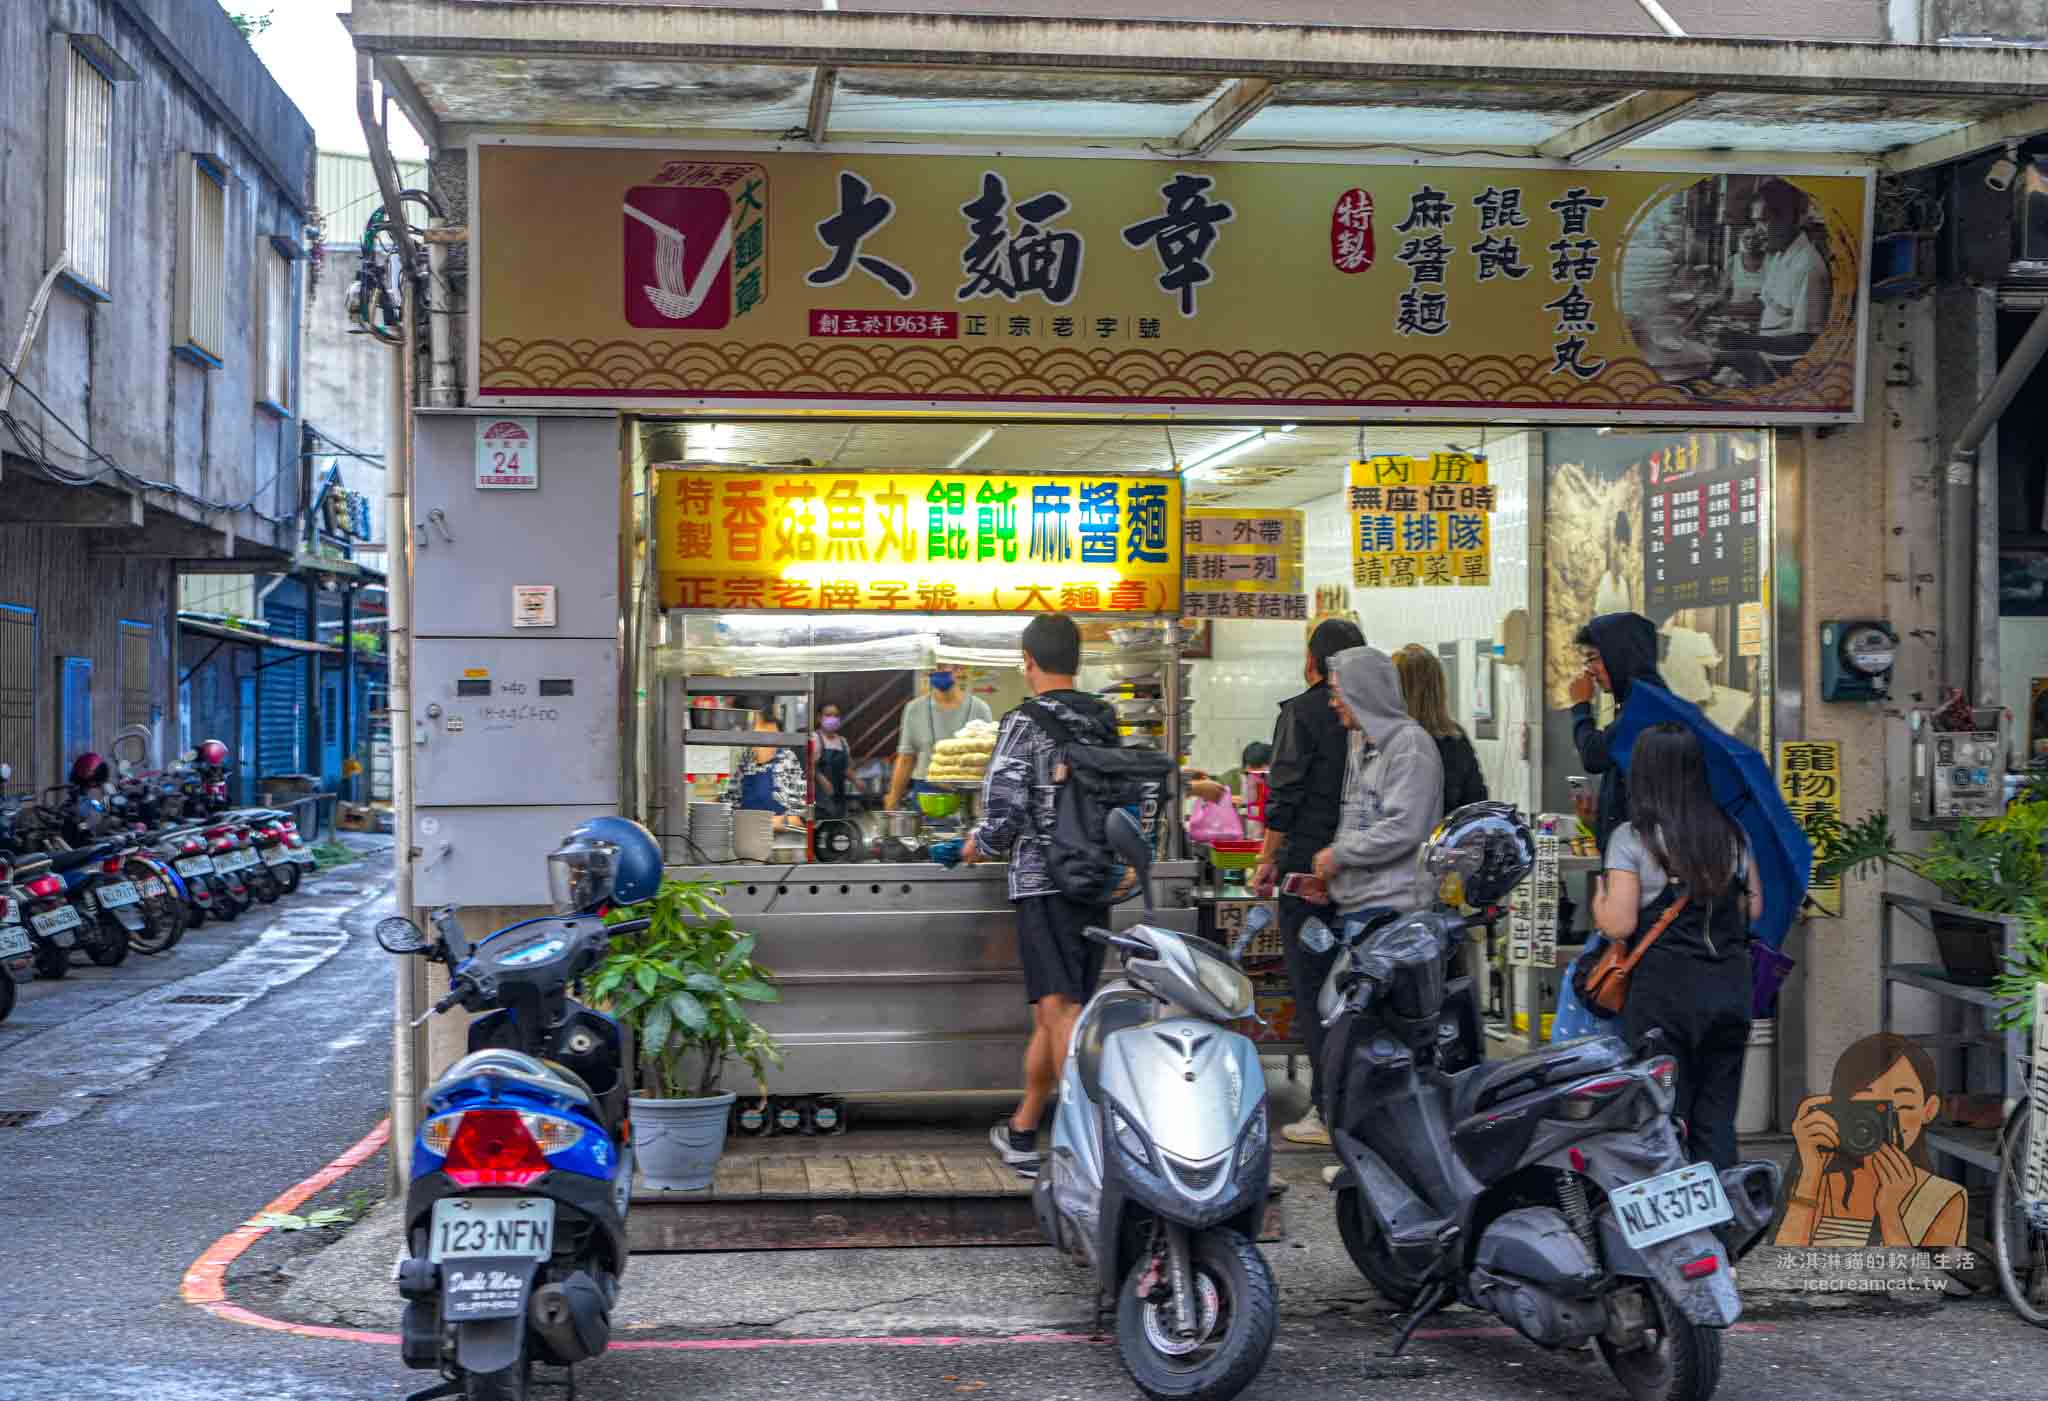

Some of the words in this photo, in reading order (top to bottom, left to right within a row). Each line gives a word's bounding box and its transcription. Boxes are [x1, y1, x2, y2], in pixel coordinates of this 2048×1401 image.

[807, 171, 1232, 318] 大麵章
[1336, 189, 1375, 271] 特製
[1471, 186, 1531, 283] 餛飩
[1395, 185, 1456, 336] 麻醬麵
[1543, 185, 1607, 378] 香菇魚丸
[818, 313, 949, 336] 創立於1963年
[493, 451, 520, 474] 24
[676, 477, 713, 561] 特製
[1351, 485, 1496, 512] 無座位時
[1360, 514, 1484, 552] 請排隊
[1354, 556, 1489, 587] 請寫菜單
[1620, 1178, 1719, 1235] NLK-3757
[440, 1219, 548, 1253] 123-NFN
